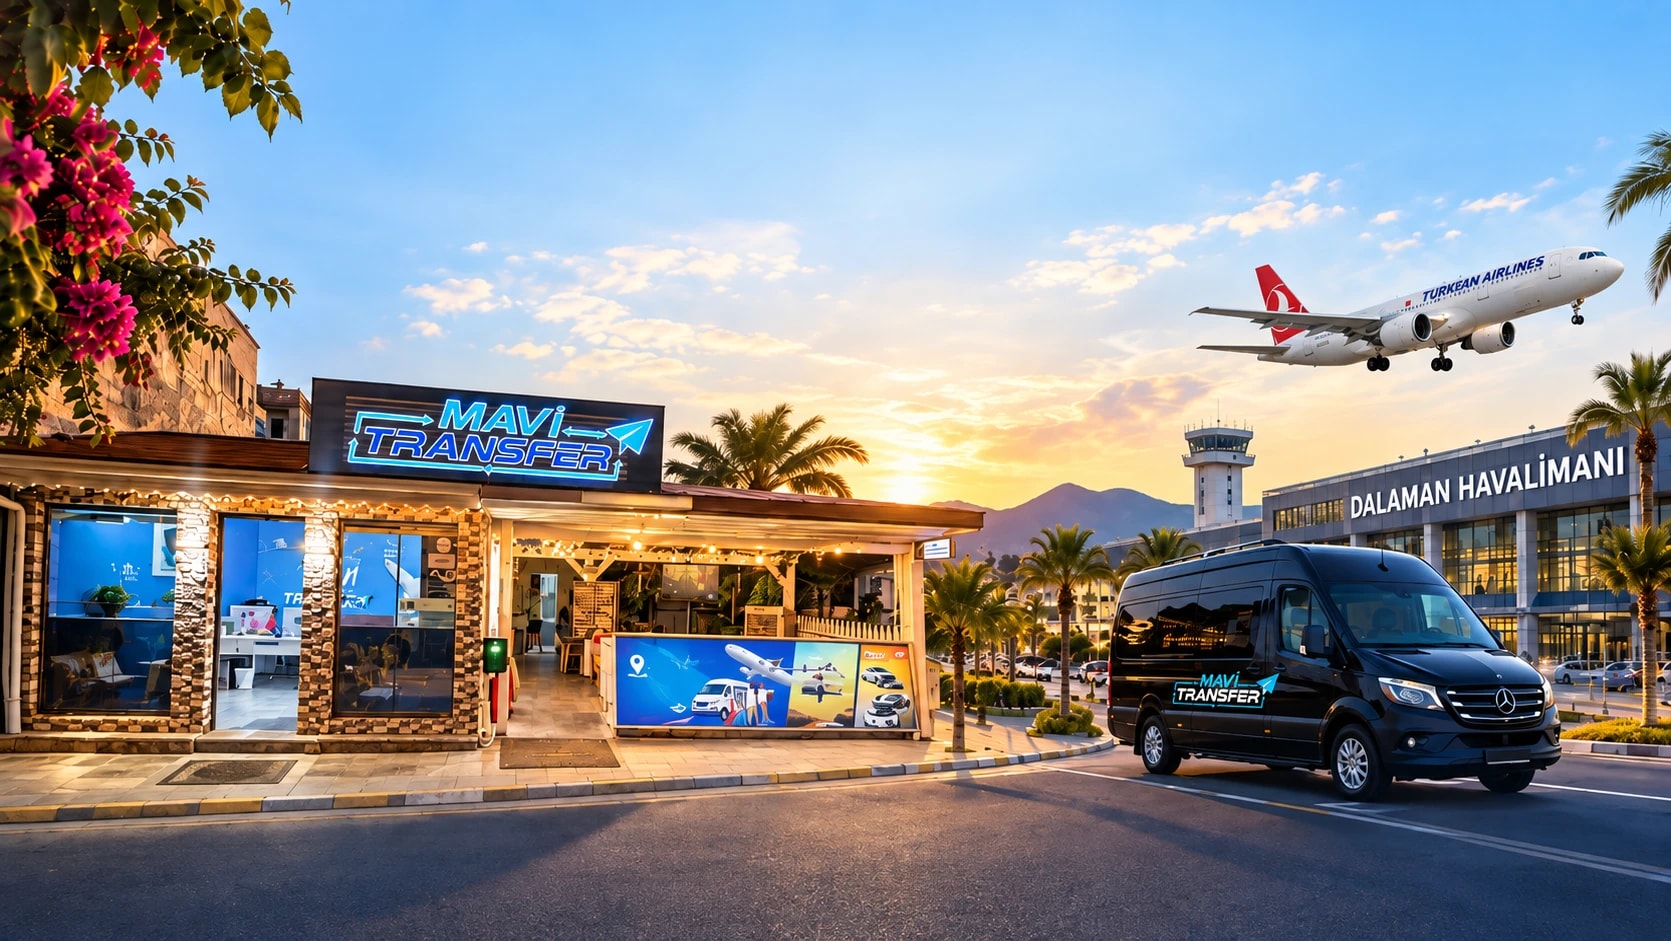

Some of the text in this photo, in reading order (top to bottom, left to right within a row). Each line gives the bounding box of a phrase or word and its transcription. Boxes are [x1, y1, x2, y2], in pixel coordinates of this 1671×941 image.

[1482, 256, 1545, 283] AIRLINES
[364, 426, 613, 470] TRANSFER
[1351, 446, 1624, 519] DALAMAN HAVALİMANI
[1177, 688, 1260, 704] TRANSFER
